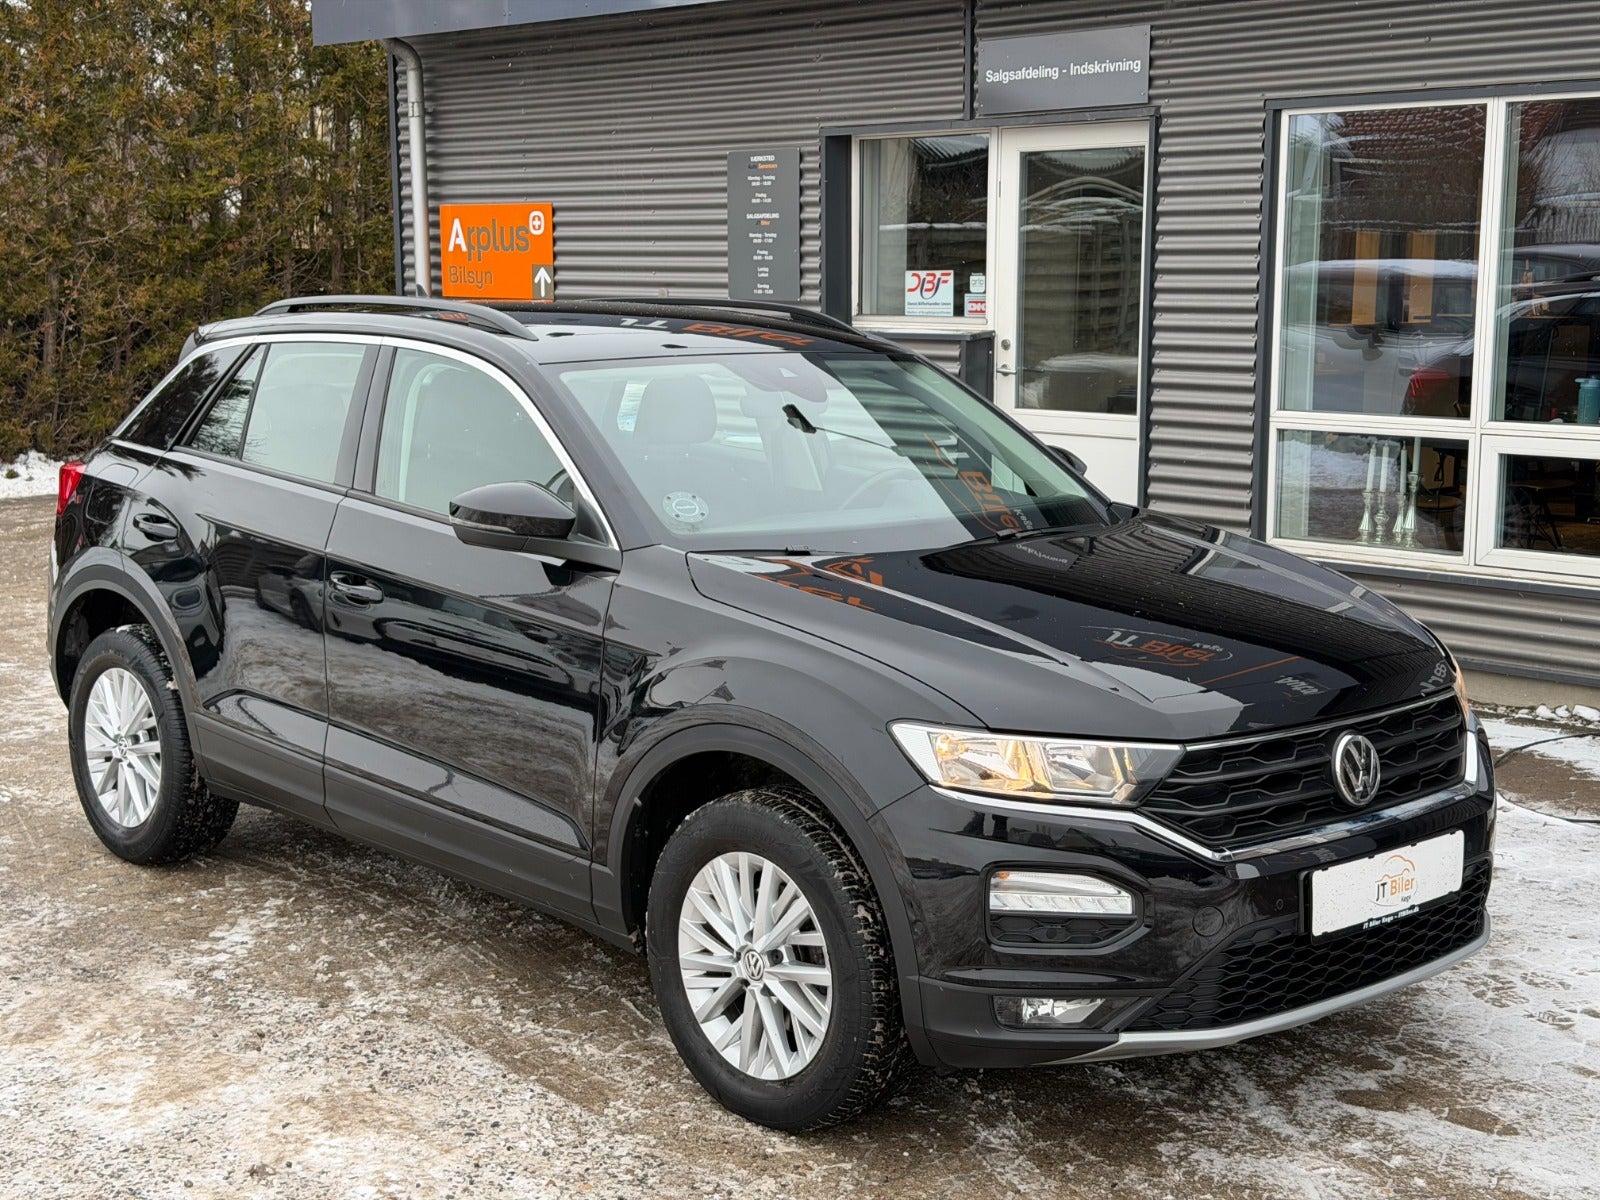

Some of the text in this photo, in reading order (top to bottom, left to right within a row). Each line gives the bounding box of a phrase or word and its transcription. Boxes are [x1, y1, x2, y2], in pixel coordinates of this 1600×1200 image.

[985, 65, 1059, 84] Salgsafdeling
[1069, 58, 1142, 76] Indskrivning
[448, 265, 493, 290] Bilsyn
[1390, 876, 1415, 896] Biler
